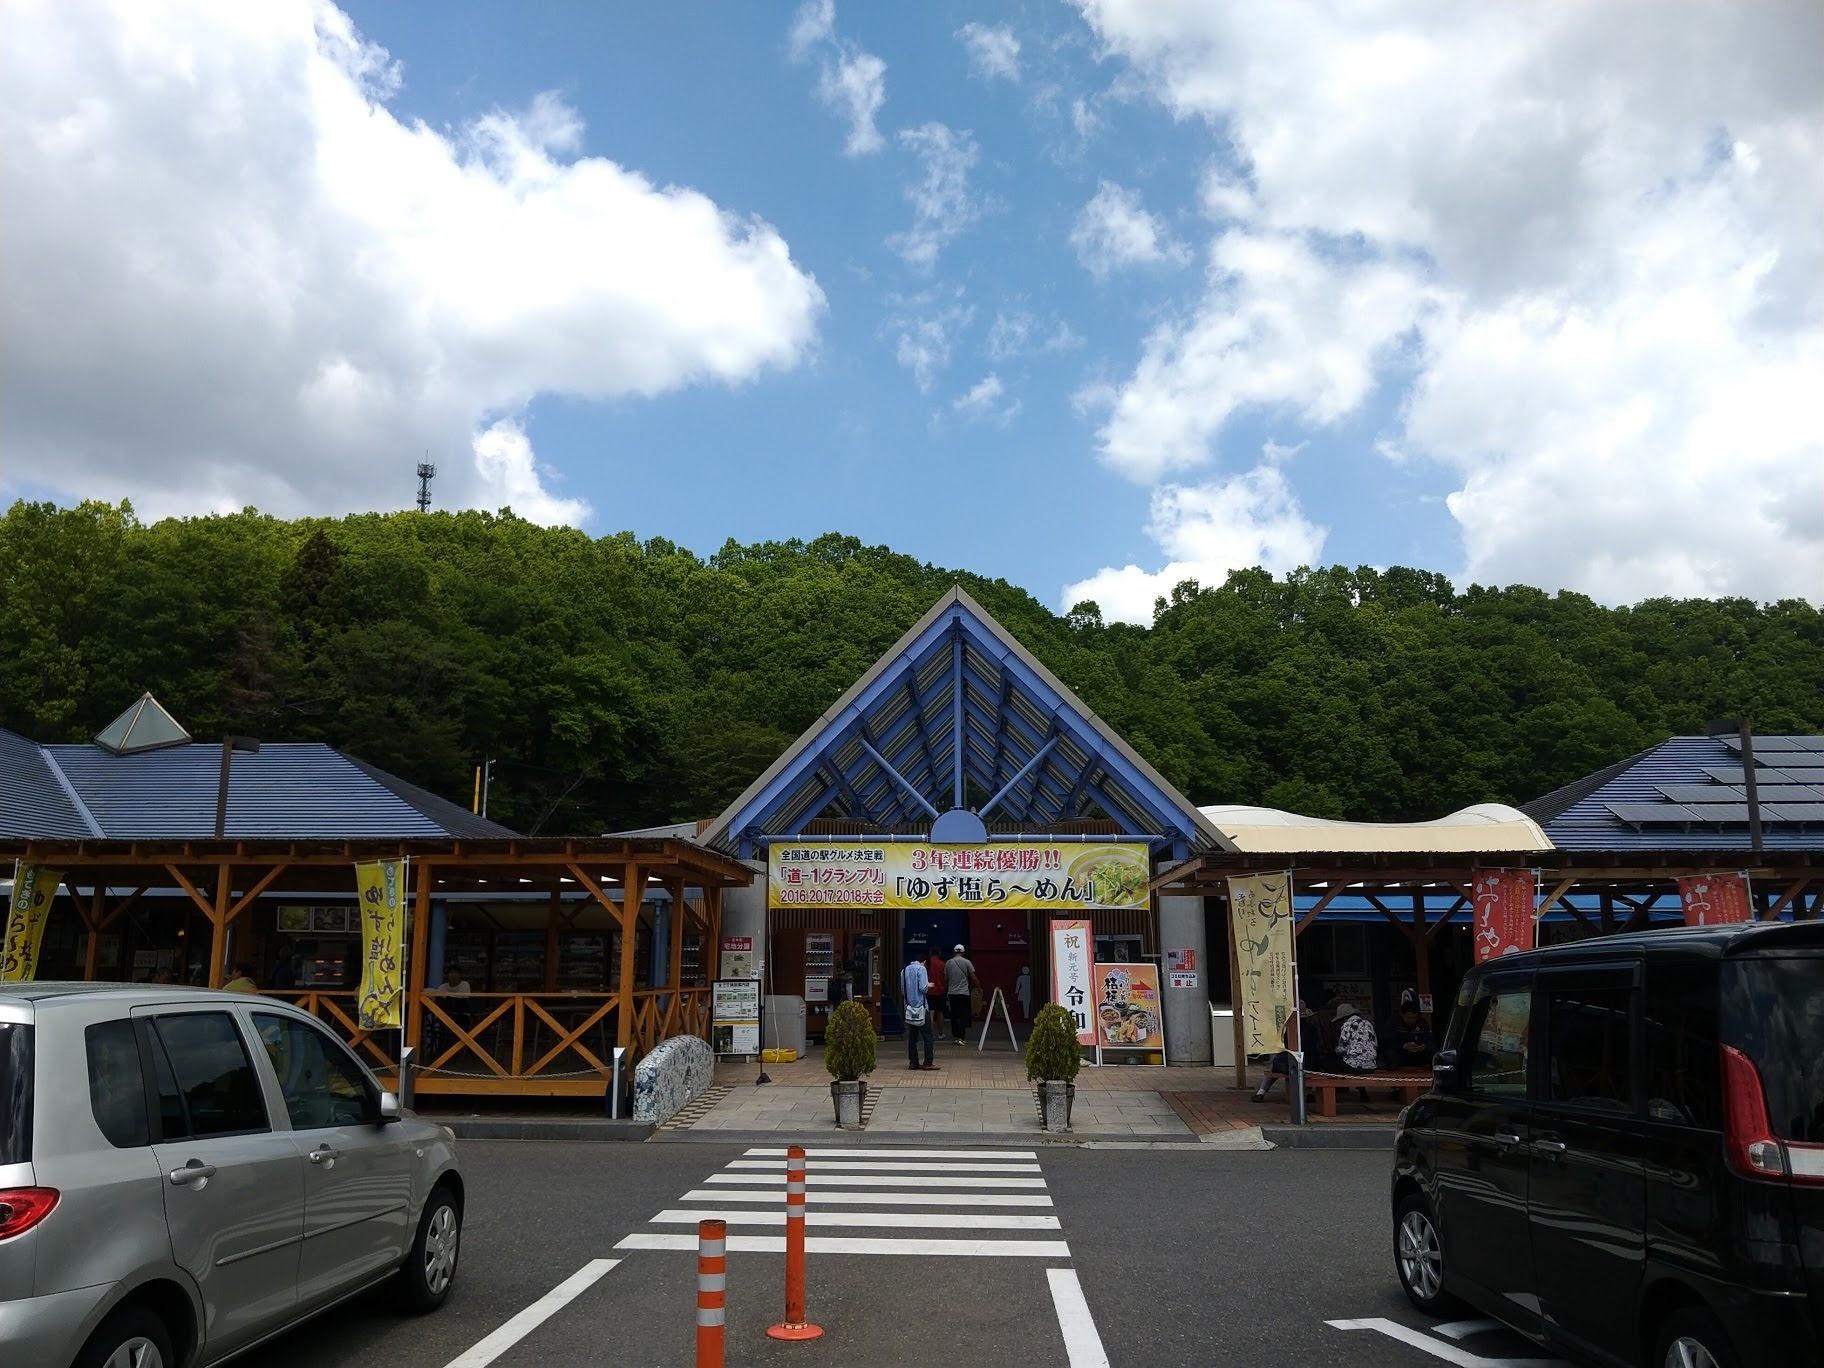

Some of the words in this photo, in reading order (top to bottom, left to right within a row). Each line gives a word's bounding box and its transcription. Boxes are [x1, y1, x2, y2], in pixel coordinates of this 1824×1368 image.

[782, 850, 883, 861] 全国道の駅グルメ決定戦
[912, 850, 1061, 869] 3年連続優勝!!
[781, 889, 883, 903] 2016.2017.2018大会
[896, 876, 1094, 901] 「ゆず塩ら〜めん」
[1064, 934, 1080, 949] 祝
[1068, 952, 1079, 983] 新元号
[1174, 979, 1193, 987] 禁止
